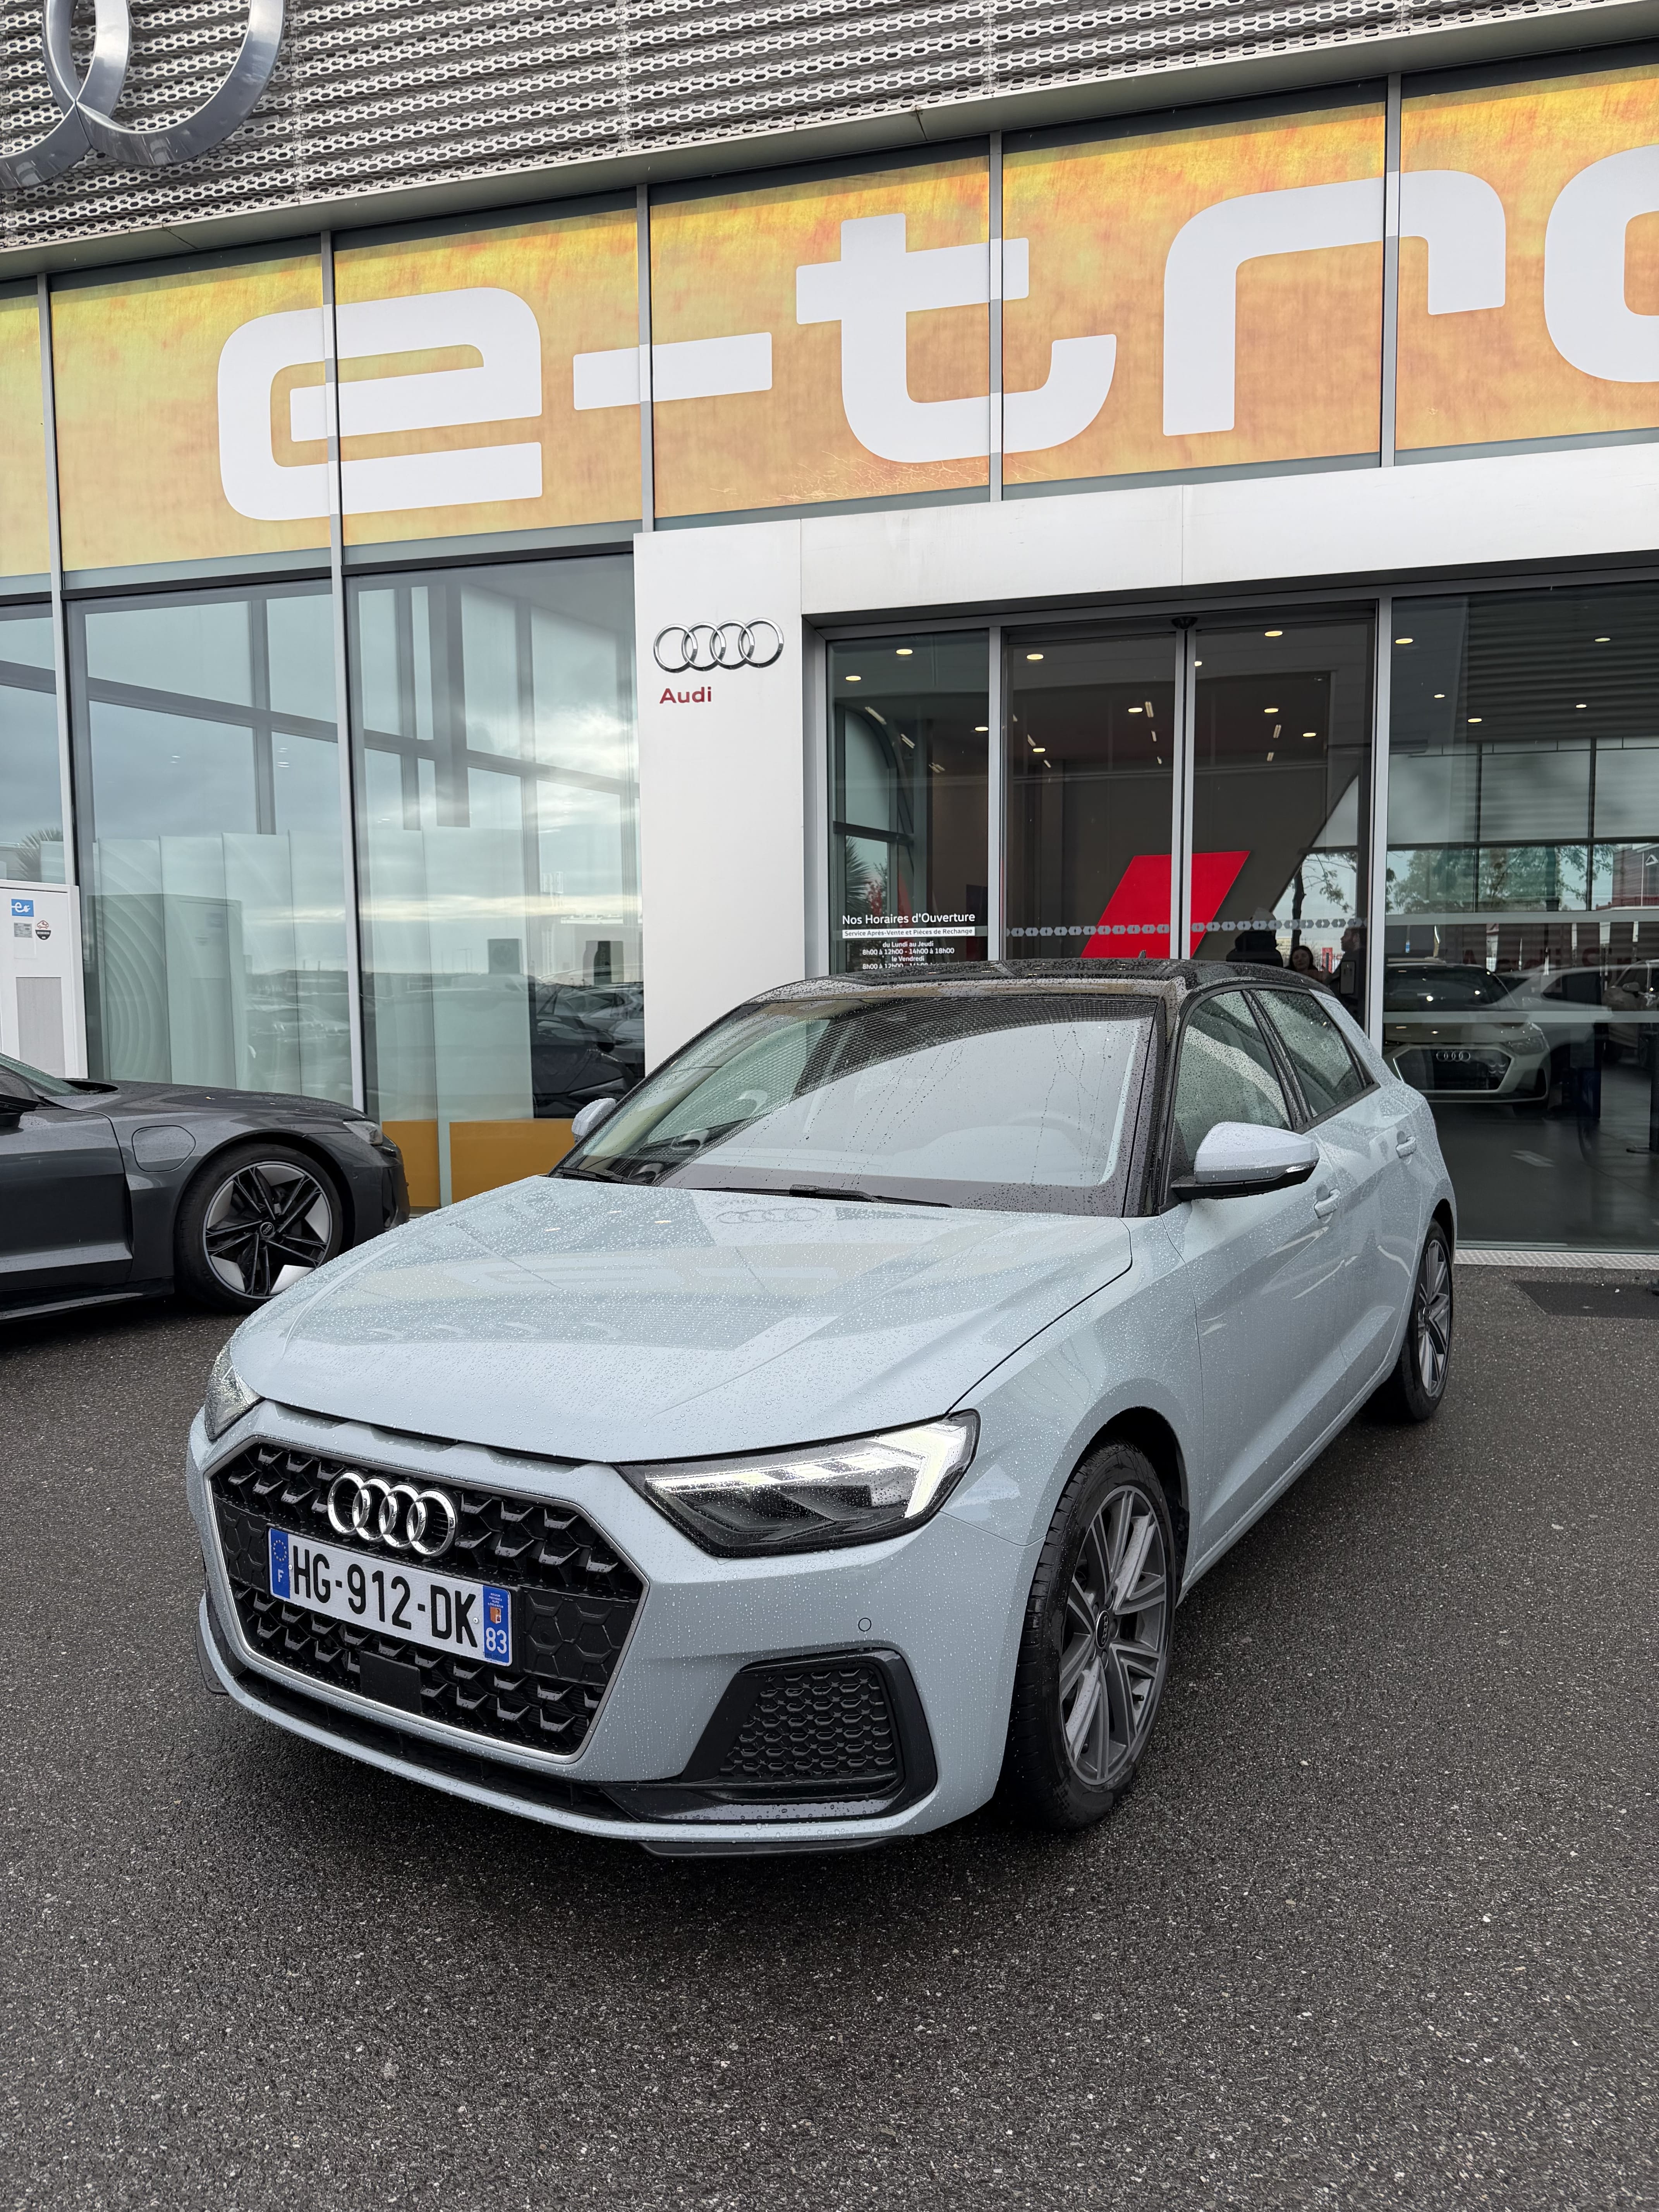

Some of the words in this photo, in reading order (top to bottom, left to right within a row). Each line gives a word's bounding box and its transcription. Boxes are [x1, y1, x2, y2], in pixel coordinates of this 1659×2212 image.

[659, 687, 711, 704] Audi
[842, 915, 862, 924] Nos
[865, 914, 909, 924] Horaires
[912, 913, 975, 922] d'Ouverture
[278, 1569, 284, 1583] F
[293, 1545, 478, 1648] HG-912-DK
[486, 1627, 507, 1654] 83
